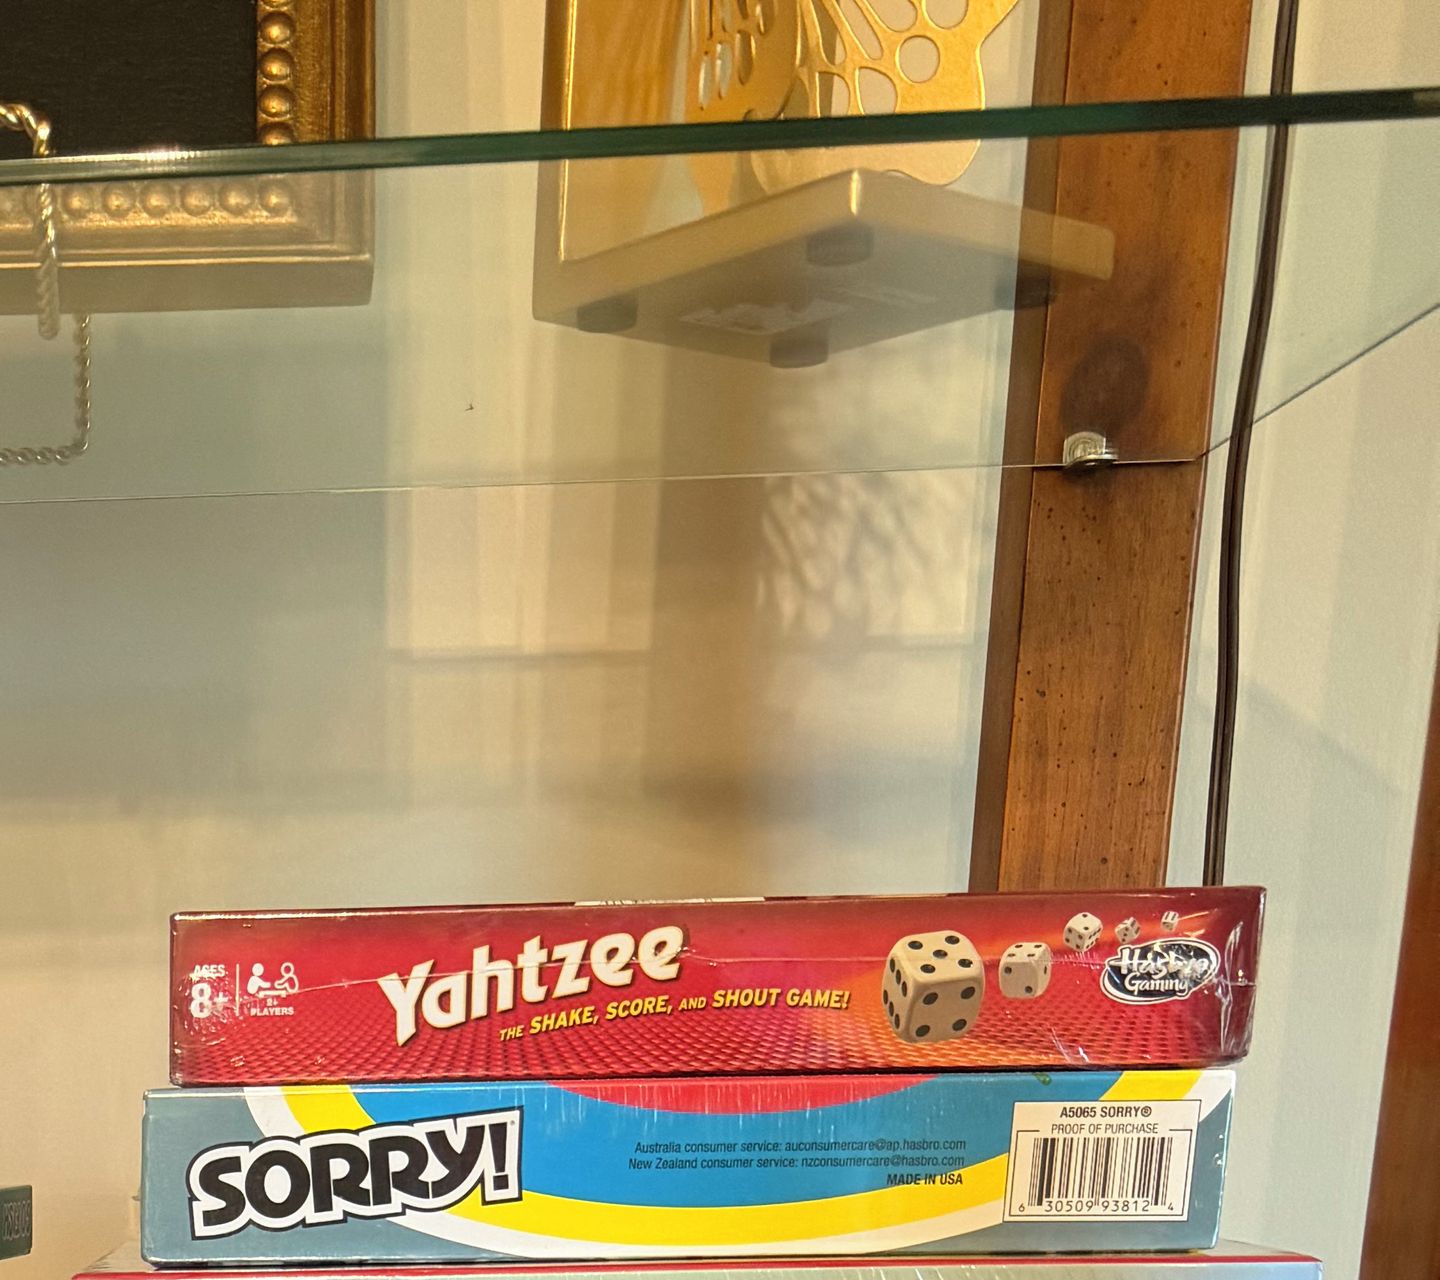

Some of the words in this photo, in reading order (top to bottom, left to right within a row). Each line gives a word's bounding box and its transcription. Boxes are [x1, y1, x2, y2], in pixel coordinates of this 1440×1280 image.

[377, 925, 687, 1047] Yahtzee
[1124, 973, 1189, 997] Gaming
[498, 1025, 524, 1041] THE
[529, 1011, 599, 1036] SHAKE,
[605, 994, 673, 1021] SCORE,
[678, 994, 707, 1010] AND
[712, 988, 781, 1010] SHOUT
[785, 989, 851, 1010] GAME!
[1060, 1106, 1097, 1118] A5065
[1051, 1124, 1086, 1134] PROOF
[1088, 1124, 1103, 1134] OF
[1104, 1123, 1159, 1134] PURCHASE
[635, 1140, 681, 1154] Australia
[684, 1141, 738, 1152] consumer
[741, 1140, 782, 1153] service:
[628, 1158, 653, 1170] New
[655, 1156, 698, 1170] Zealand
[701, 1158, 754, 1169] consumer
[756, 1157, 799, 1168] service:
[194, 1114, 515, 1232] SORRY!
[886, 1174, 921, 1185] MADE
[923, 1174, 936, 1185] IN
[939, 1173, 963, 1185] USA
[1017, 1202, 1025, 1213] 6
[1044, 1200, 1094, 1212] 30509
[1102, 1200, 1150, 1212] 93812
[1167, 1202, 1174, 1212] 4
